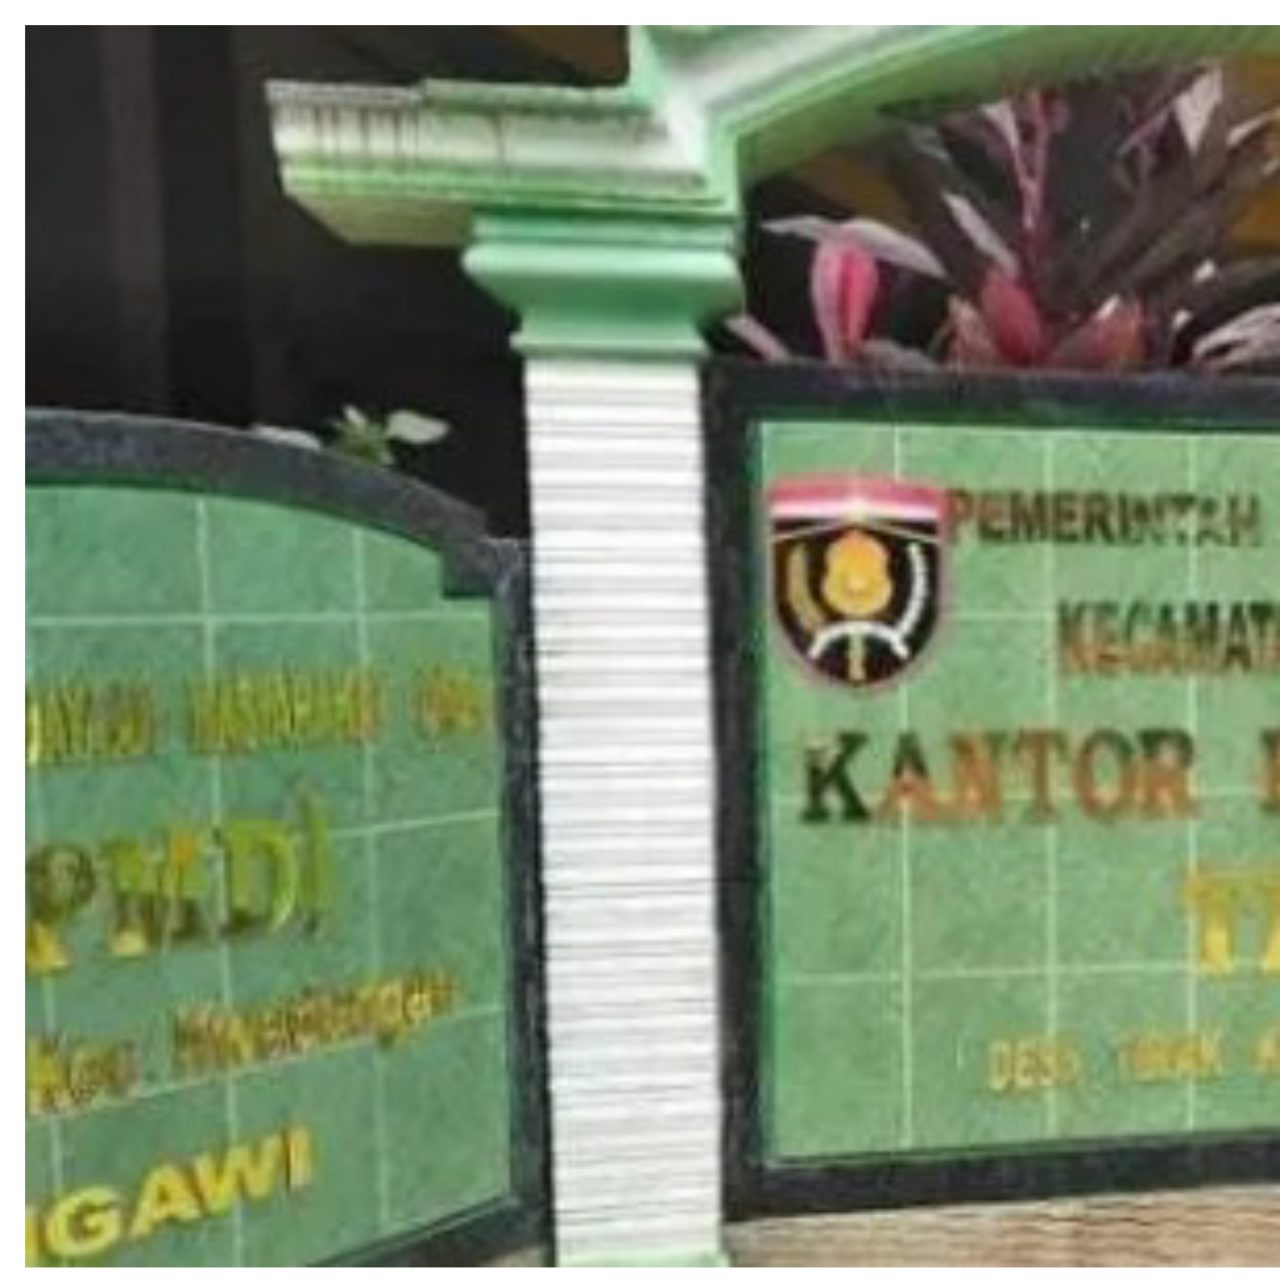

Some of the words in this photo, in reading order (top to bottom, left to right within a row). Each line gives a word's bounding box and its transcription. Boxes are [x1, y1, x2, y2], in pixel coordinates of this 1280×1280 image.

[944, 490, 1262, 546] PEMERINTAH
[802, 730, 1196, 826] KANTOR
[25, 1124, 314, 1265] GAWI
